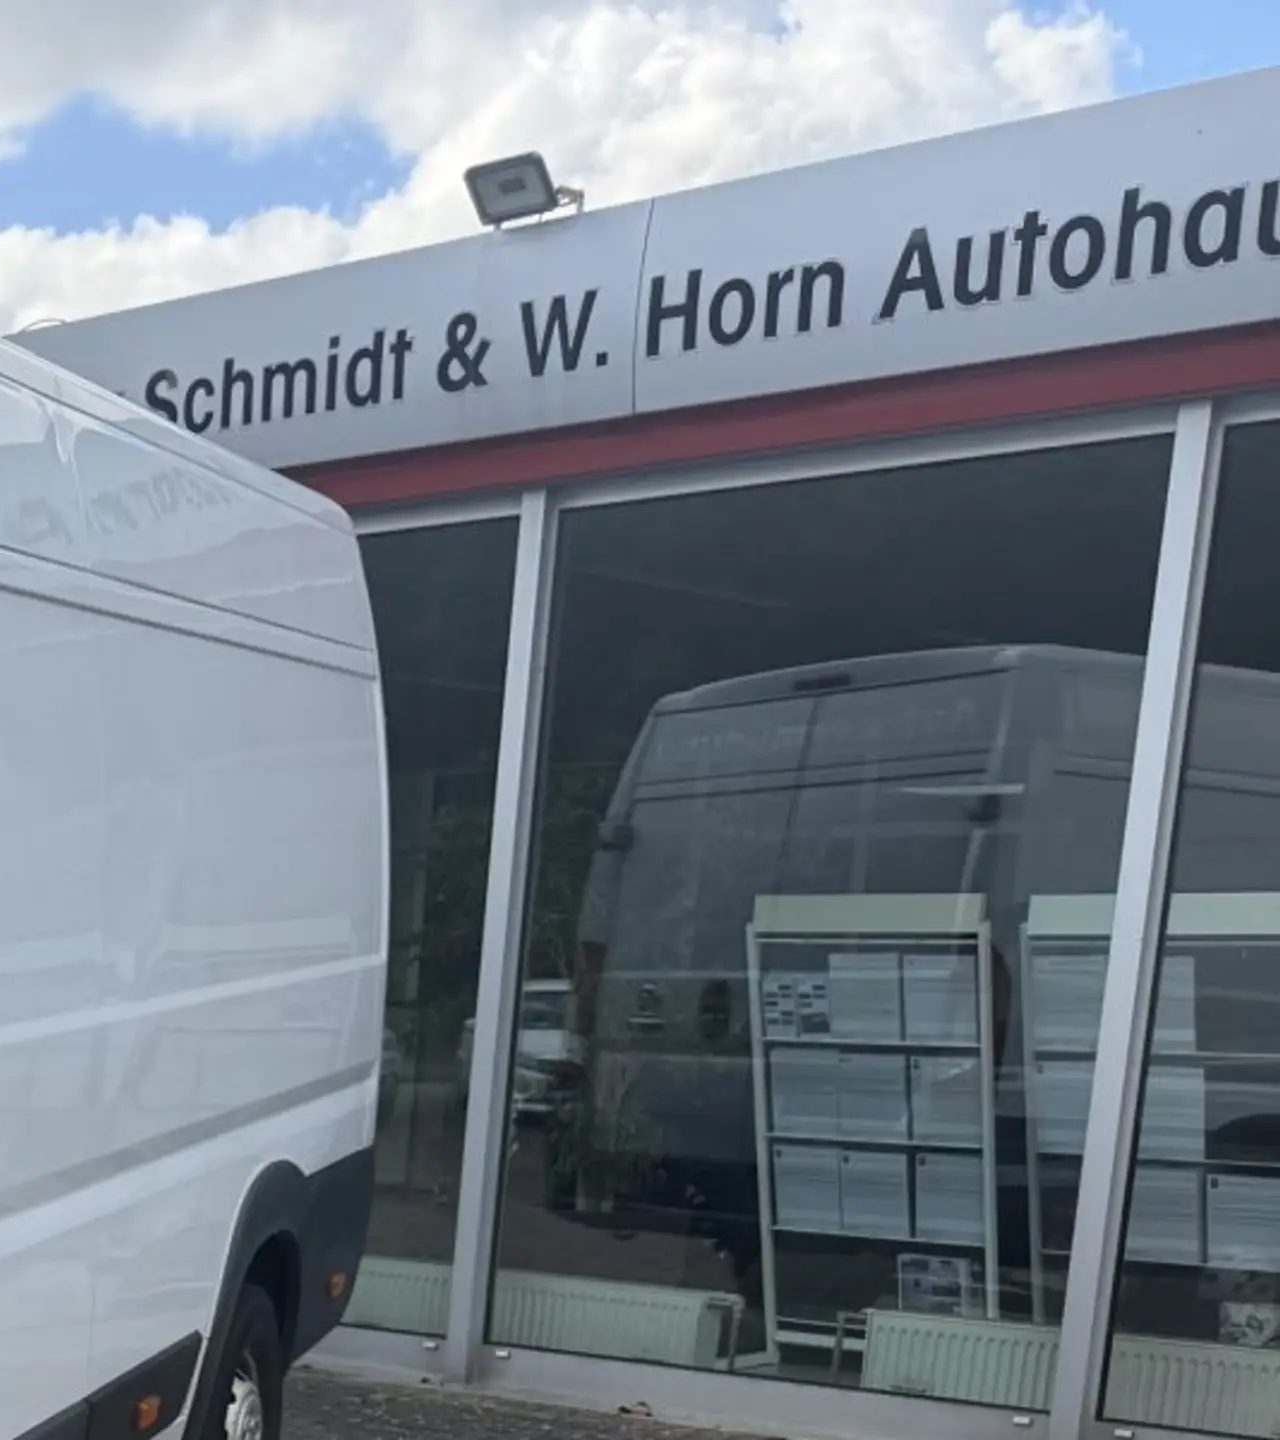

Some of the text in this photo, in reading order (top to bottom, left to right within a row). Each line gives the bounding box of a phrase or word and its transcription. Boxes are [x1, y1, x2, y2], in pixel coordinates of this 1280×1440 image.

[144, 328, 414, 434] Schmidt
[437, 311, 492, 392] &
[520, 290, 609, 377] W.
[645, 259, 846, 358] Horn
